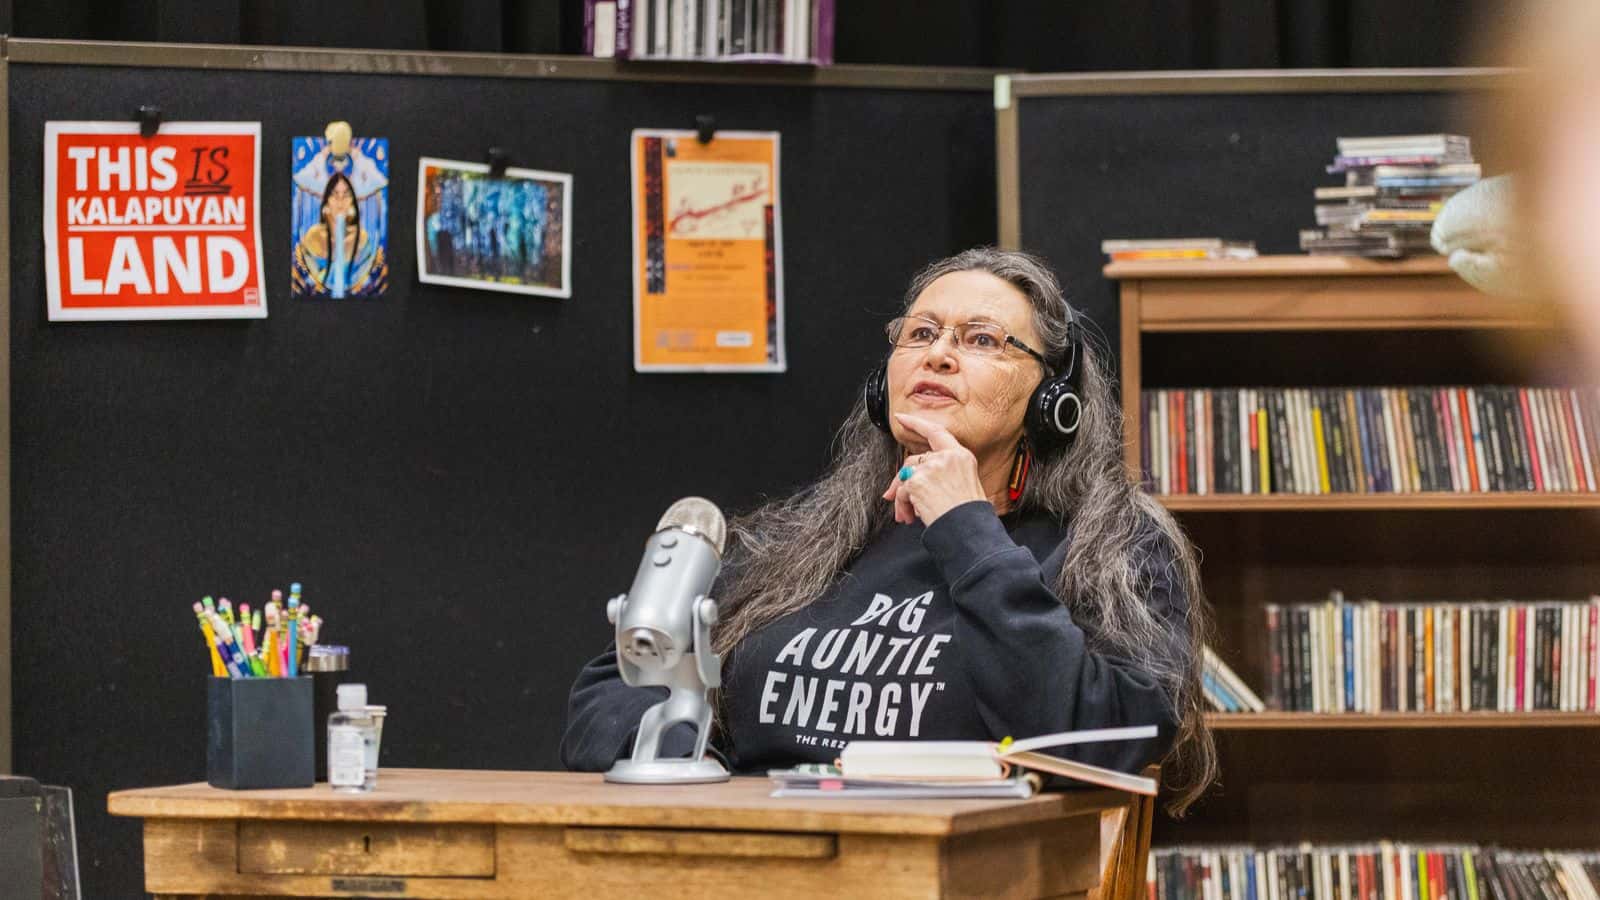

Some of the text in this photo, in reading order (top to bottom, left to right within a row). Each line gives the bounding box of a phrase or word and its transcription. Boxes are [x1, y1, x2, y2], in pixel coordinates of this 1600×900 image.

[68, 147, 230, 191] THIS IS
[67, 196, 246, 225] KALAPUYAN
[68, 236, 250, 295] LAND
[850, 590, 934, 633] BIG
[775, 627, 952, 676] AUNTIE
[759, 671, 934, 737] ENERGY
[795, 734, 818, 746] THE
